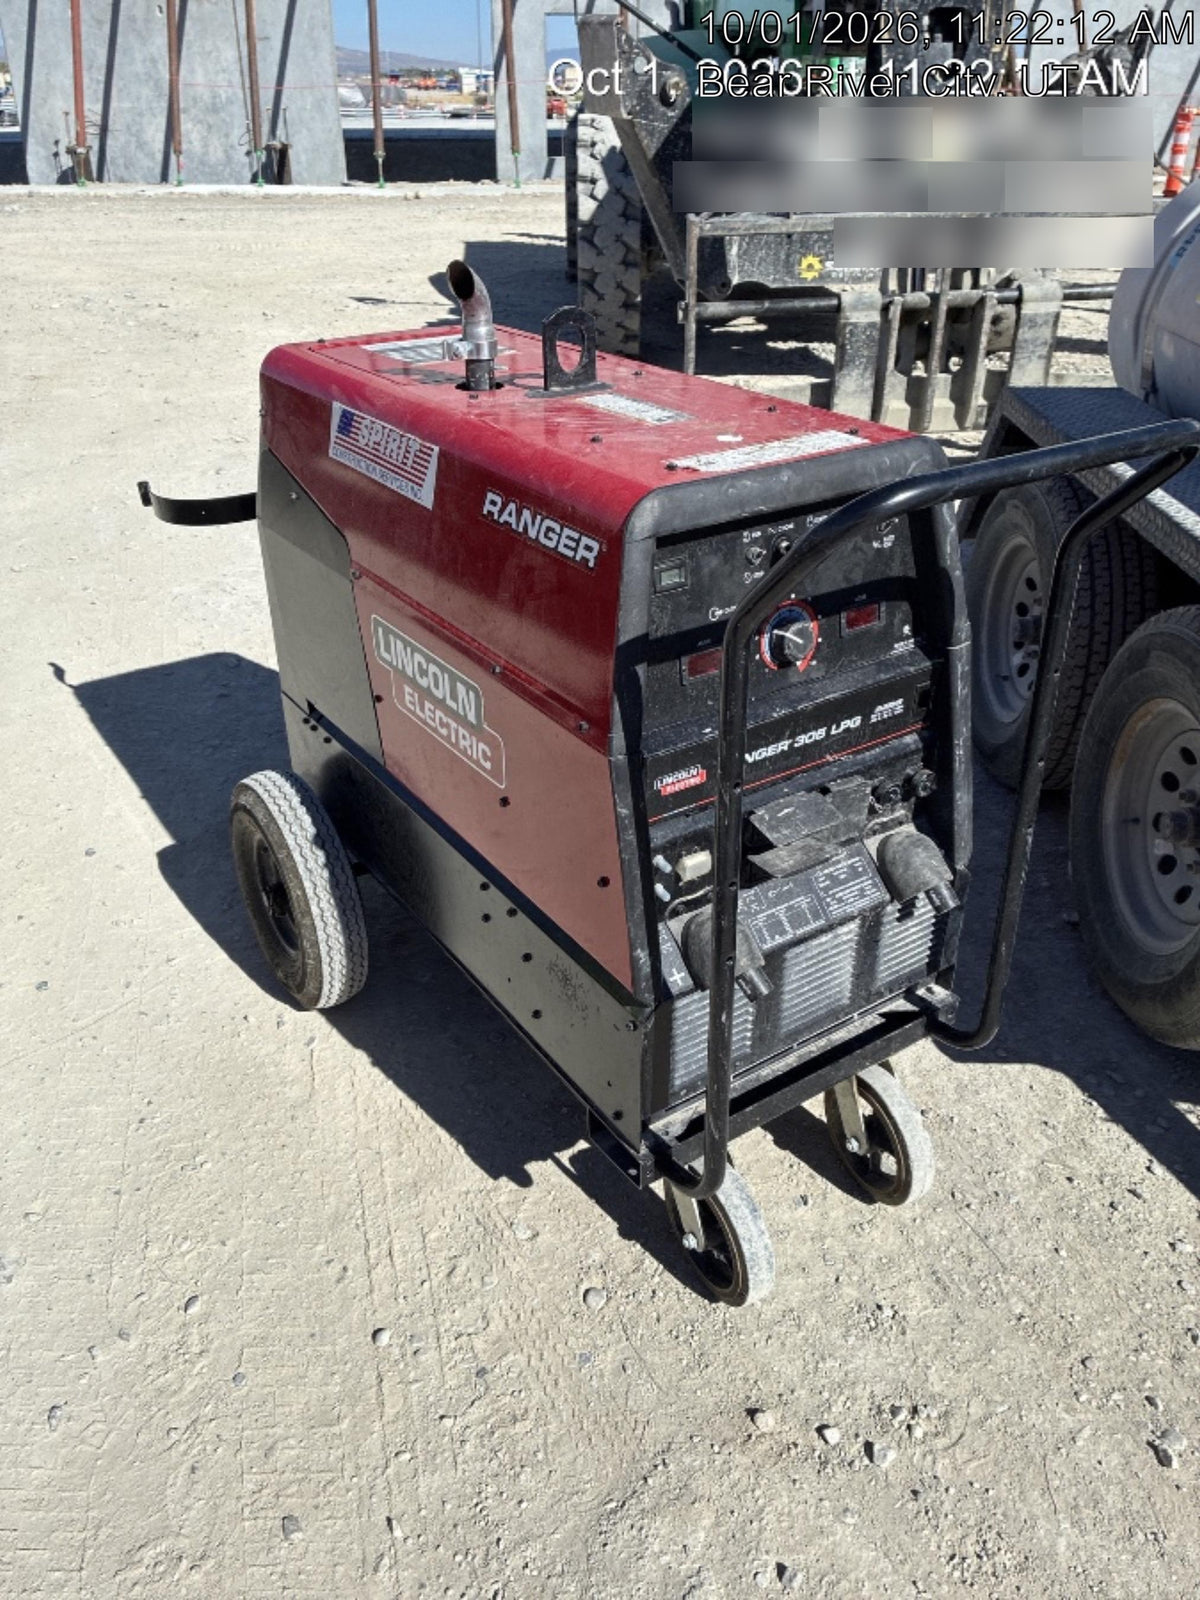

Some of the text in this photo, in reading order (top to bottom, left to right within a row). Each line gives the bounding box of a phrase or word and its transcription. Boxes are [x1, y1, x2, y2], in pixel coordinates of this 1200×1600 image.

[358, 418, 421, 469] SPIRIT
[482, 491, 601, 568] RANGER
[377, 626, 478, 724] LINCOLN
[403, 684, 493, 771] ELECTRIC
[744, 738, 793, 764] NGER
[830, 715, 862, 735] LPG
[657, 765, 699, 790] LINCOLN
